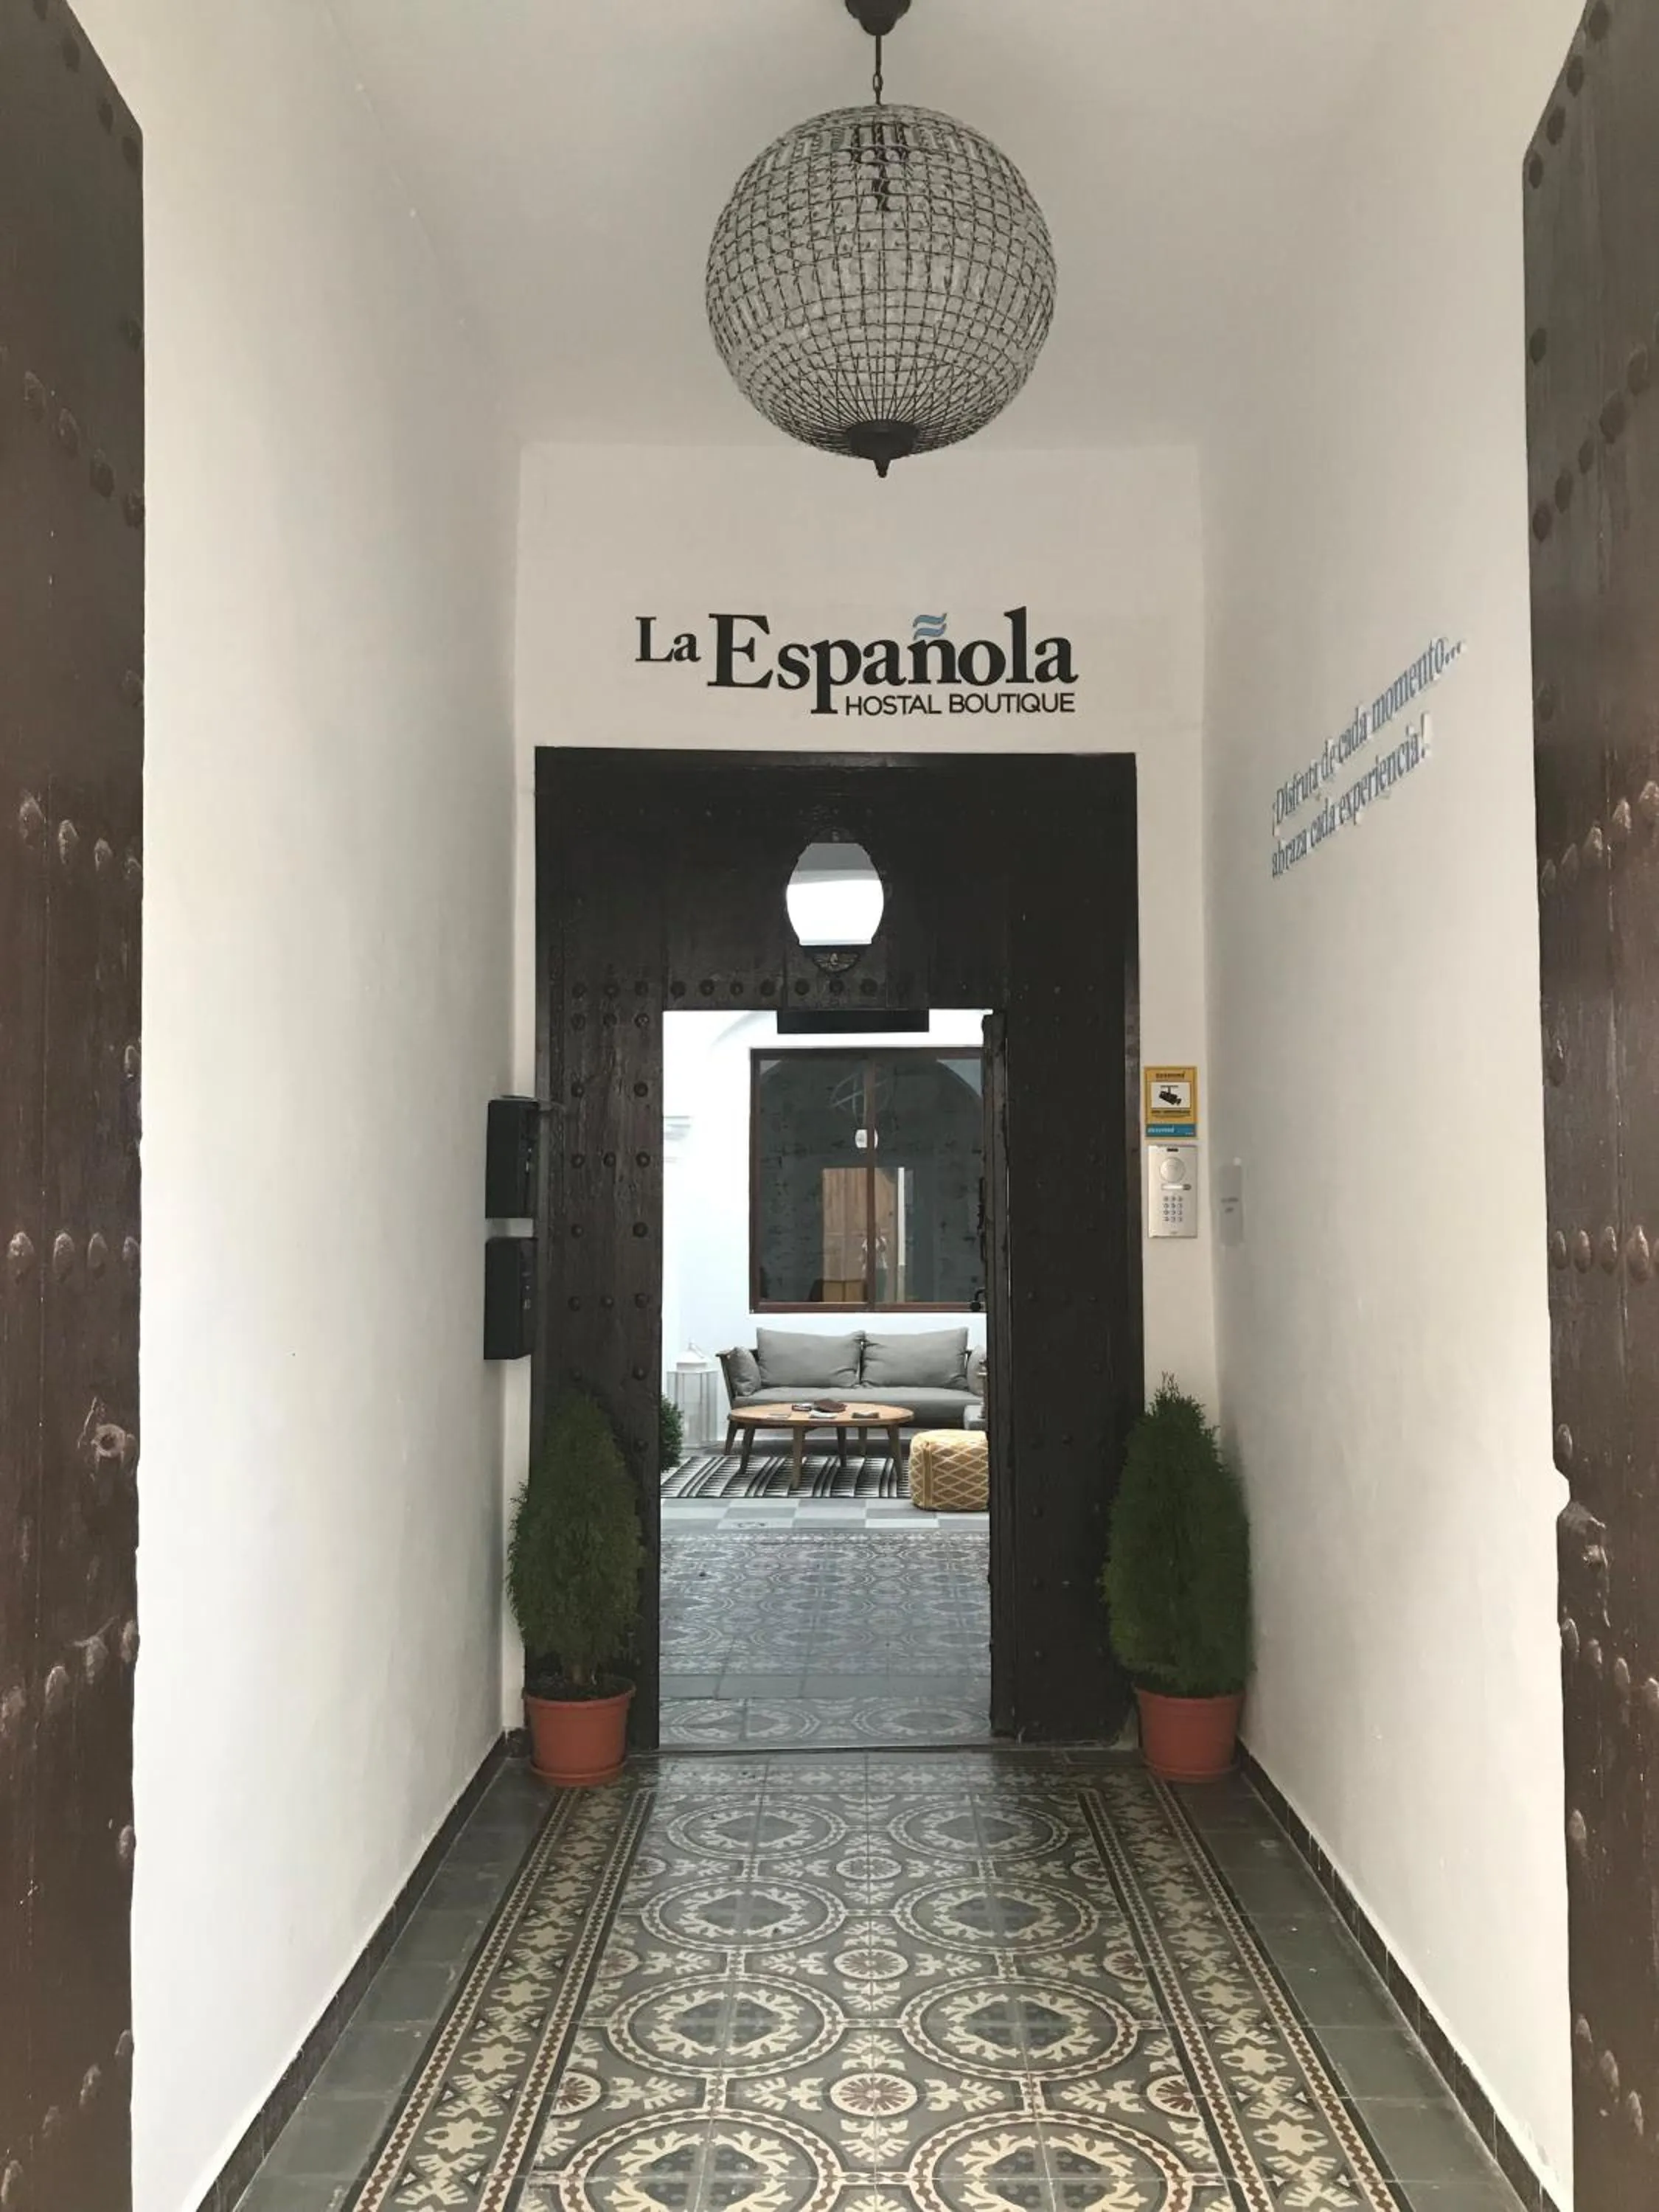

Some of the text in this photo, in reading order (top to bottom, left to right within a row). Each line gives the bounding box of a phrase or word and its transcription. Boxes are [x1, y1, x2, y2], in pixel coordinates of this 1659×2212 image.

[635, 605, 1079, 714] La Española
[846, 692, 1075, 716] HOSTAL BOUTIQUE
[1321, 739, 1336, 781] de
[1338, 706, 1368, 764] cada
[1272, 712, 1426, 878] abraza cada experiencia!
